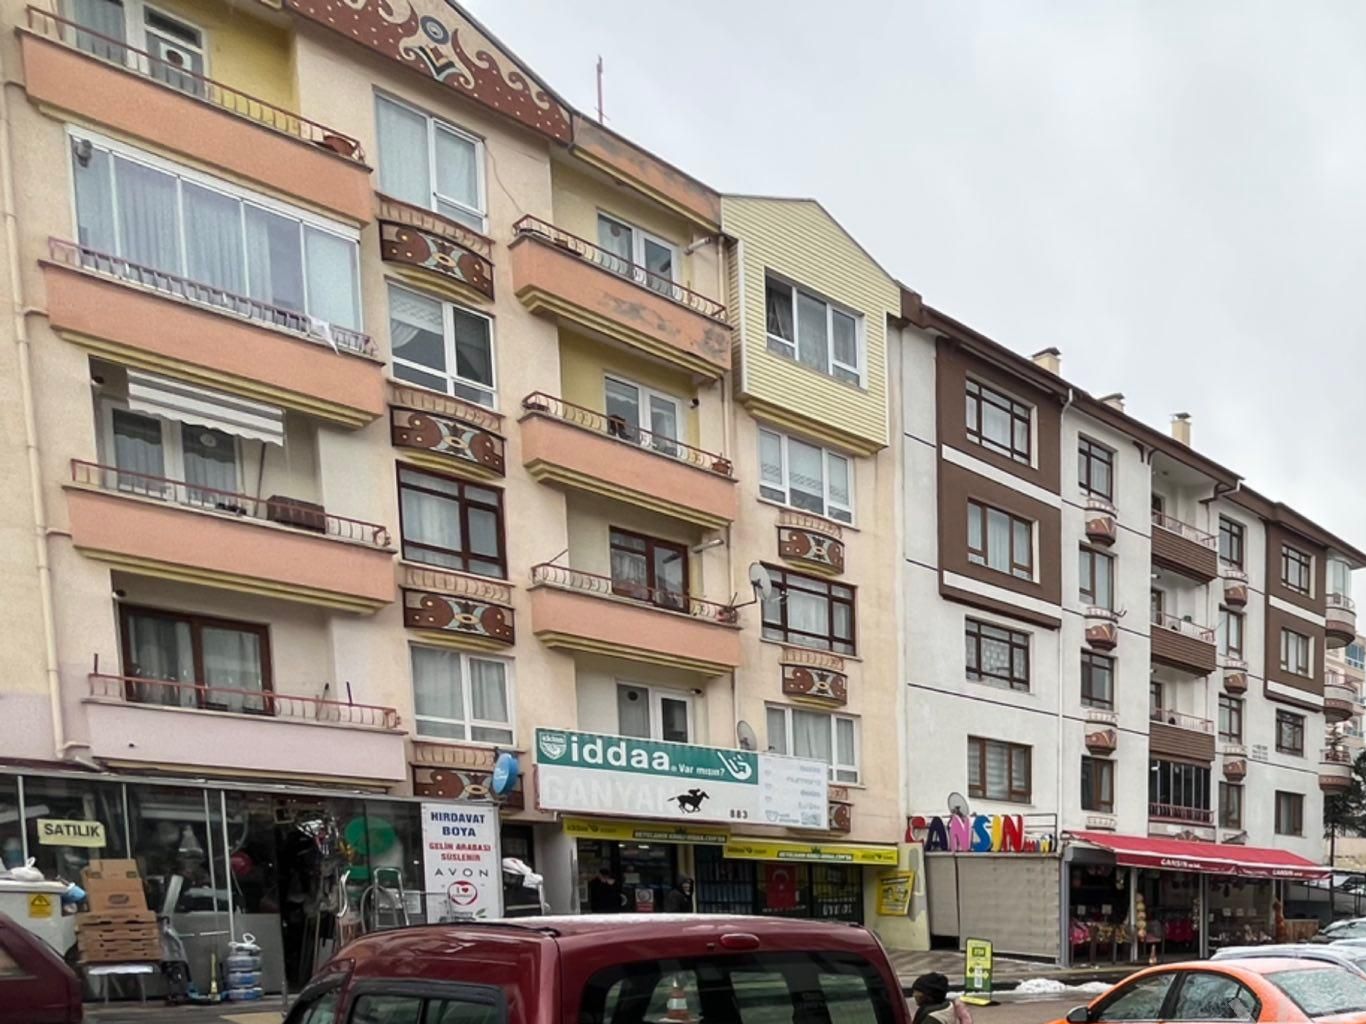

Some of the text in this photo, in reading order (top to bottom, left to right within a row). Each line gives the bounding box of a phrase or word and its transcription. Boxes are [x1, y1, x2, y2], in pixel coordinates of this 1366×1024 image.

[571, 736, 671, 771] iddaa
[679, 764, 694, 775] Var
[431, 811, 486, 824] HIRDAVAT
[730, 809, 749, 820] 883
[44, 822, 101, 838] SATILIK
[442, 826, 477, 837] BOYA
[905, 814, 1025, 853] CANSIN
[434, 867, 489, 878] AVON
